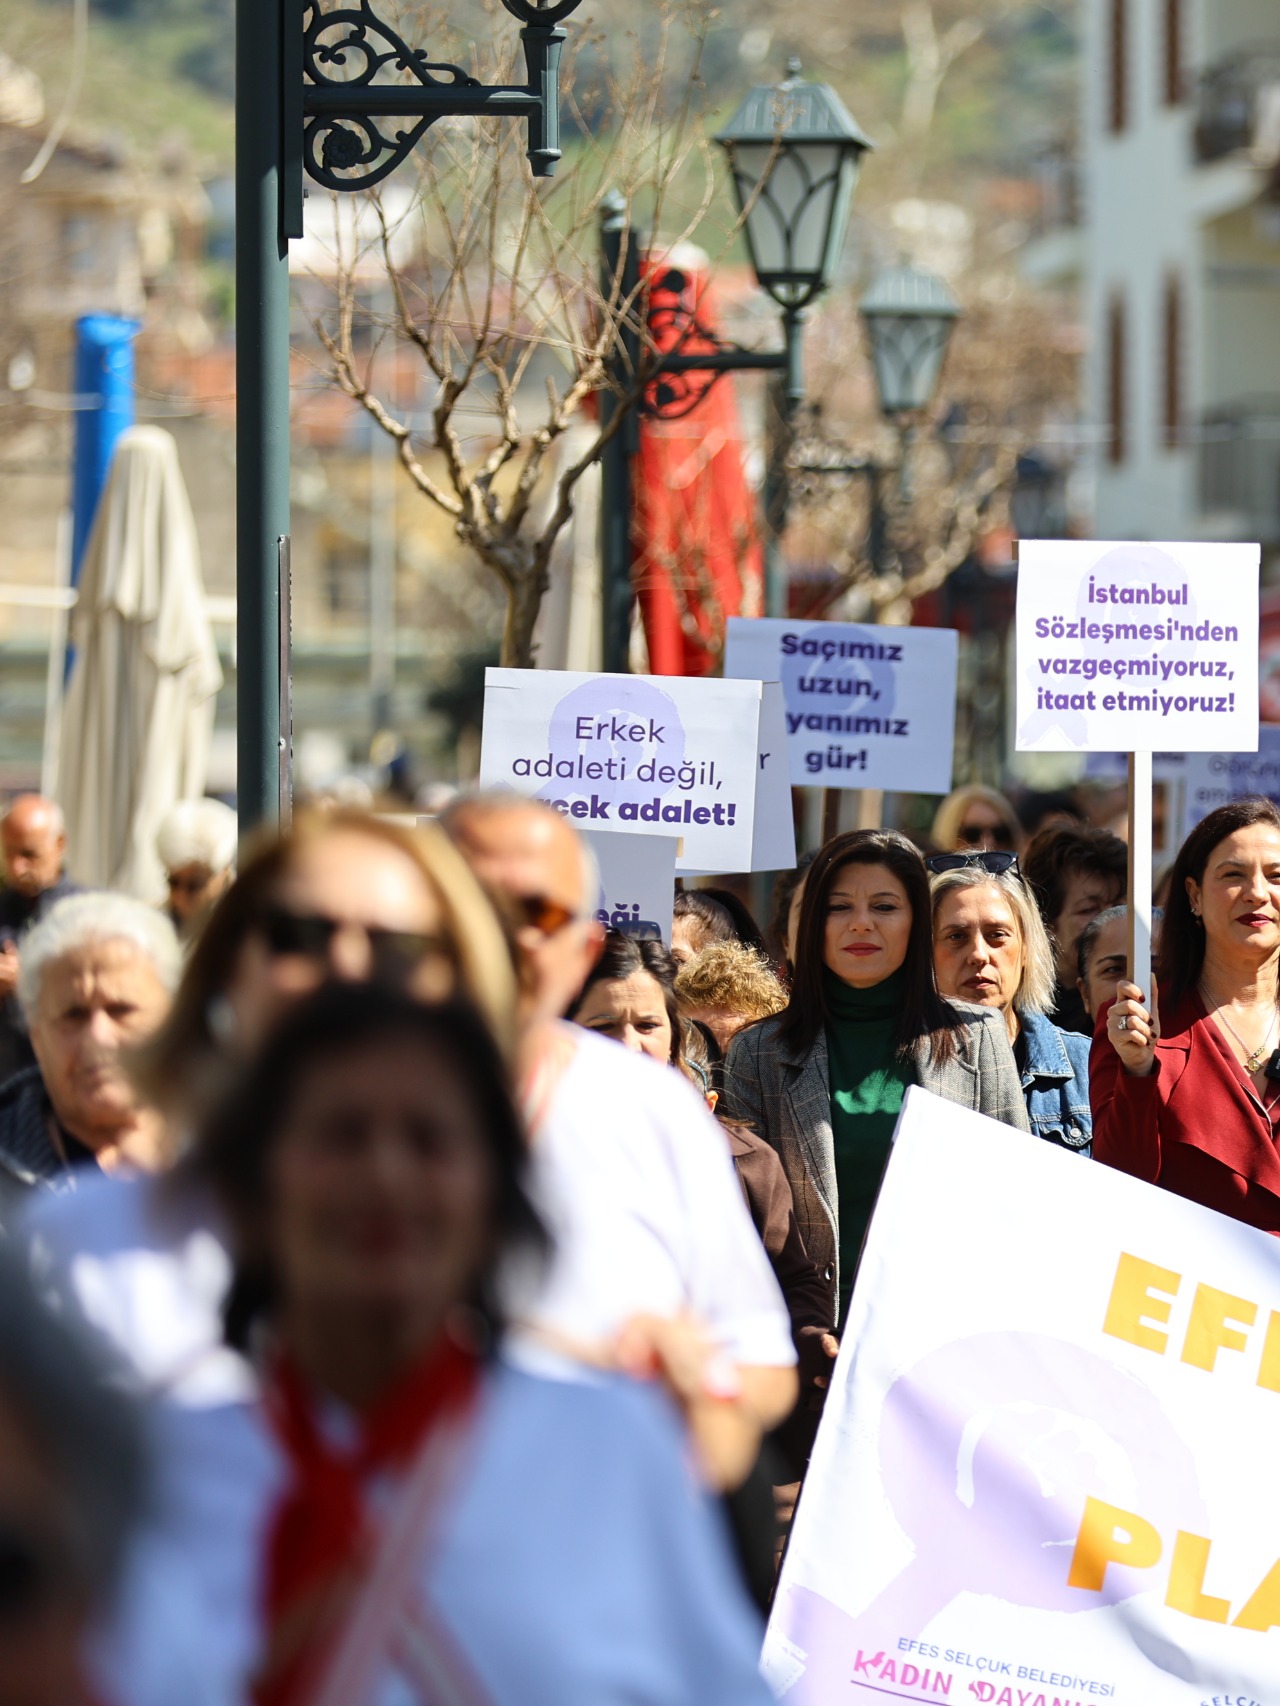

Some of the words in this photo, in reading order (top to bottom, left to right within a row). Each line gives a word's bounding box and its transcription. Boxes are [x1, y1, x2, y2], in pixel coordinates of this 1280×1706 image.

[1088, 575, 1188, 605] İstanbul
[1035, 615, 1239, 644] Sözleşmesi'nden
[780, 632, 904, 661] Saçımız
[1038, 653, 1235, 681] vazgeçmiyoruz,
[798, 675, 881, 700] uzun,
[1037, 686, 1096, 710] itaat
[1102, 688, 1236, 716] etmiyoruz!
[575, 716, 665, 743] Erkek
[512, 753, 627, 780] adaleti
[637, 758, 723, 790] değil,
[805, 745, 867, 773] gür!
[618, 798, 737, 826] adalet!
[853, 1649, 953, 1695] KADIN
[897, 1637, 940, 1658] EFES
[944, 1649, 1012, 1676] SELÇUK
[1017, 1666, 1115, 1697] BELEDİYESİ
